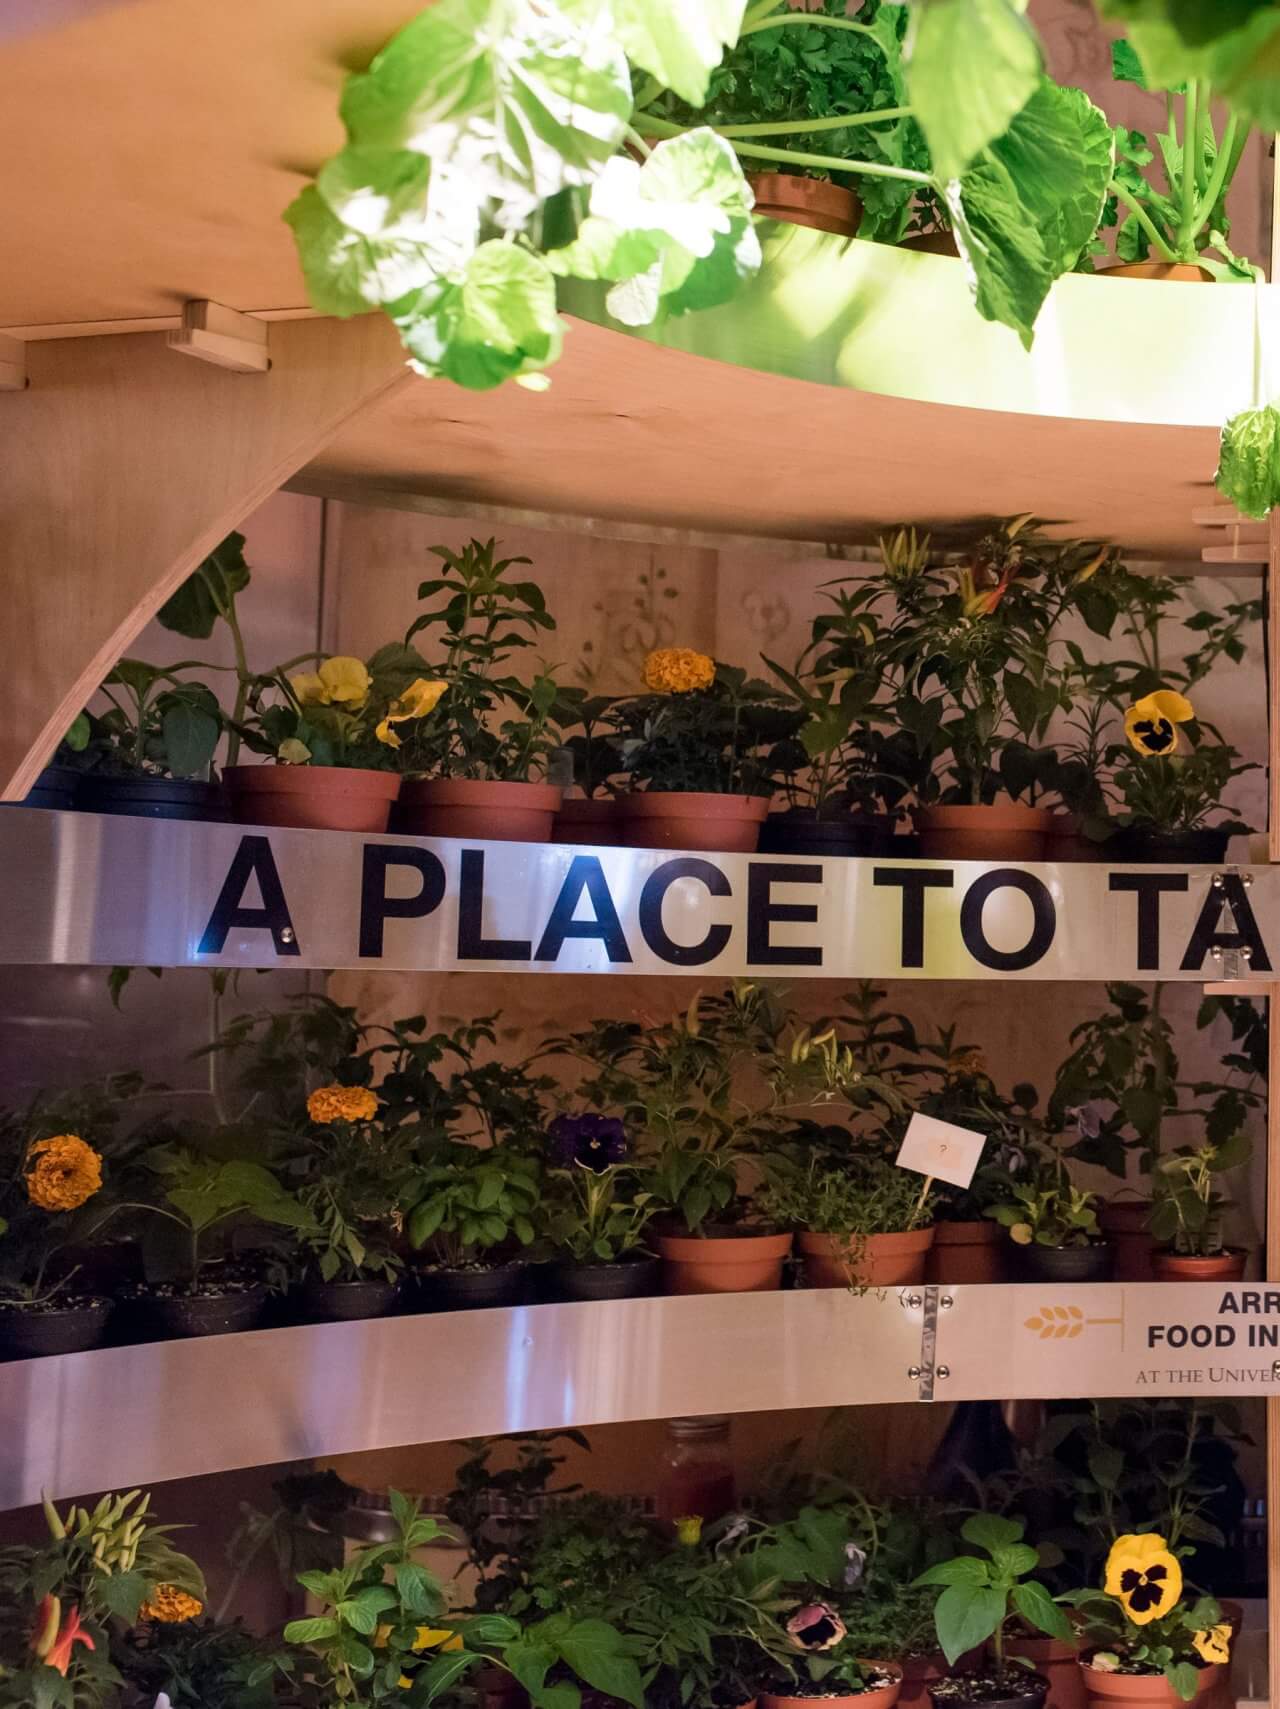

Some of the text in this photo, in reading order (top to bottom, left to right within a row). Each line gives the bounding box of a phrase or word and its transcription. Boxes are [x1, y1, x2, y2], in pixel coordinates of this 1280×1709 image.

[197, 835, 300, 956] A
[358, 843, 823, 966] PLACE
[873, 867, 1057, 972] TO
[1148, 1325, 1236, 1348] FOOD
[1136, 1369, 1161, 1384] AT
[1165, 1370, 1203, 1384] THE
